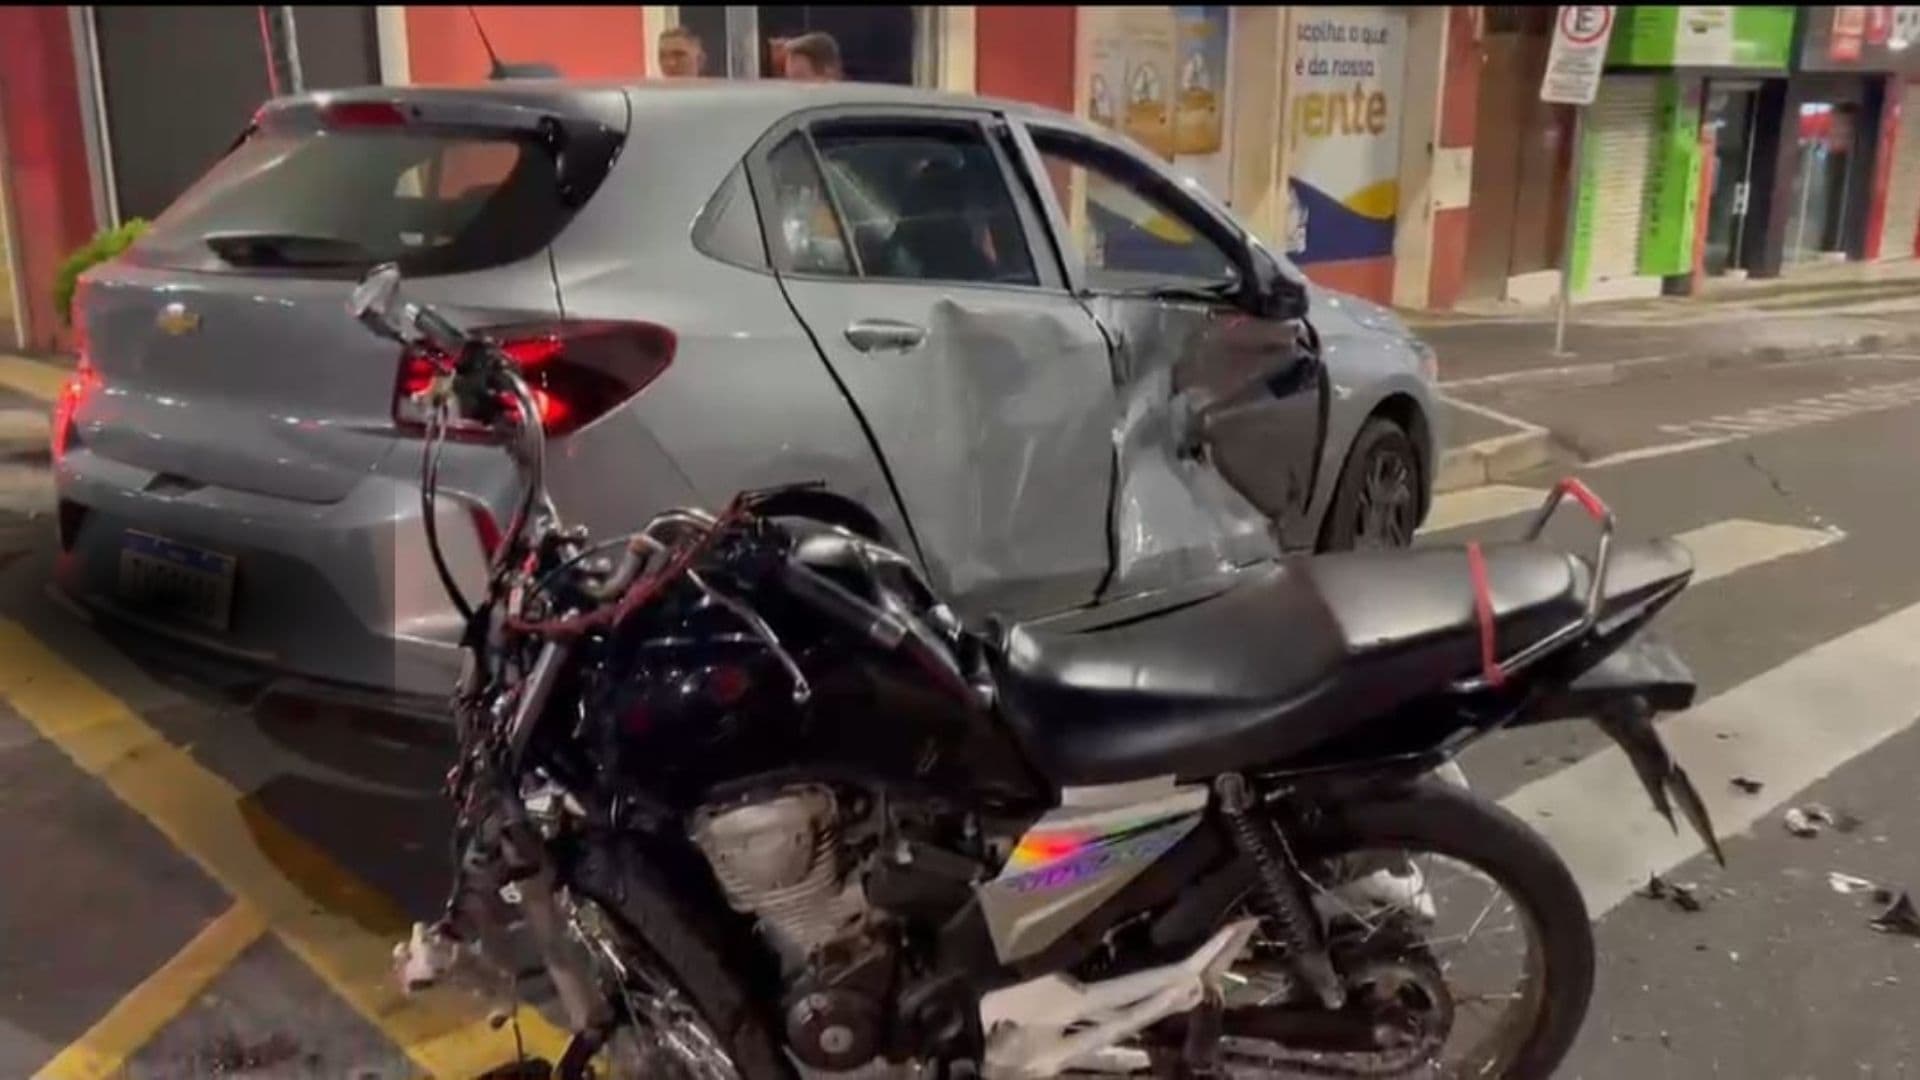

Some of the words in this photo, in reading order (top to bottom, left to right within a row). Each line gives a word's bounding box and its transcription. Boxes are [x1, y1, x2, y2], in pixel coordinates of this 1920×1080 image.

[1575, 6, 1596, 32] E
[1349, 26, 1360, 42] o
[1363, 27, 1388, 47] que
[1308, 56, 1328, 76] da
[1333, 60, 1374, 77] nossa
